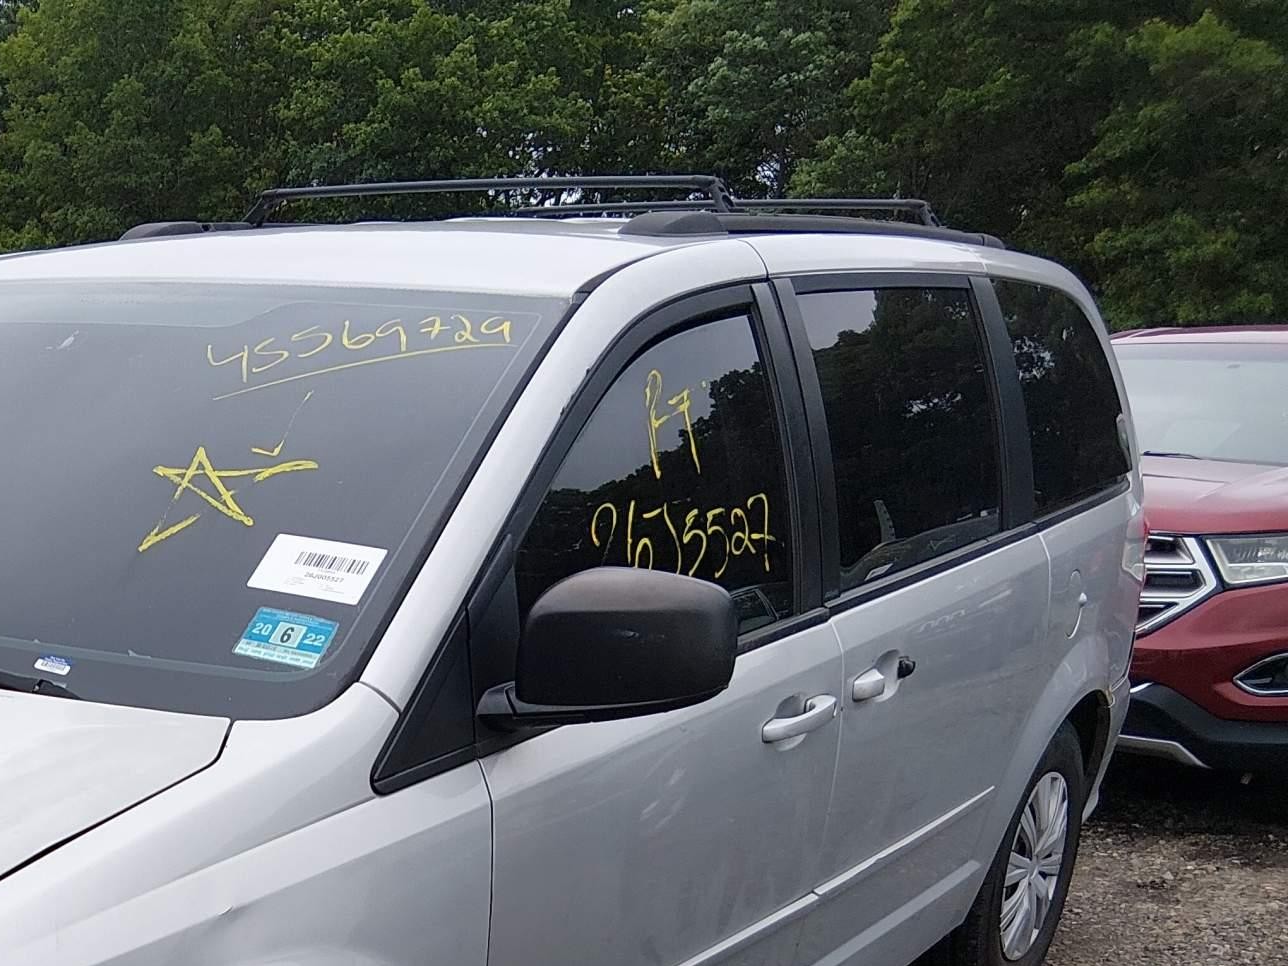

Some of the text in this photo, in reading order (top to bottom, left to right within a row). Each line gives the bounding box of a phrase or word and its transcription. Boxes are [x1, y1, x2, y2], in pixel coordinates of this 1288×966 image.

[251, 622, 326, 646] 20 6 22
